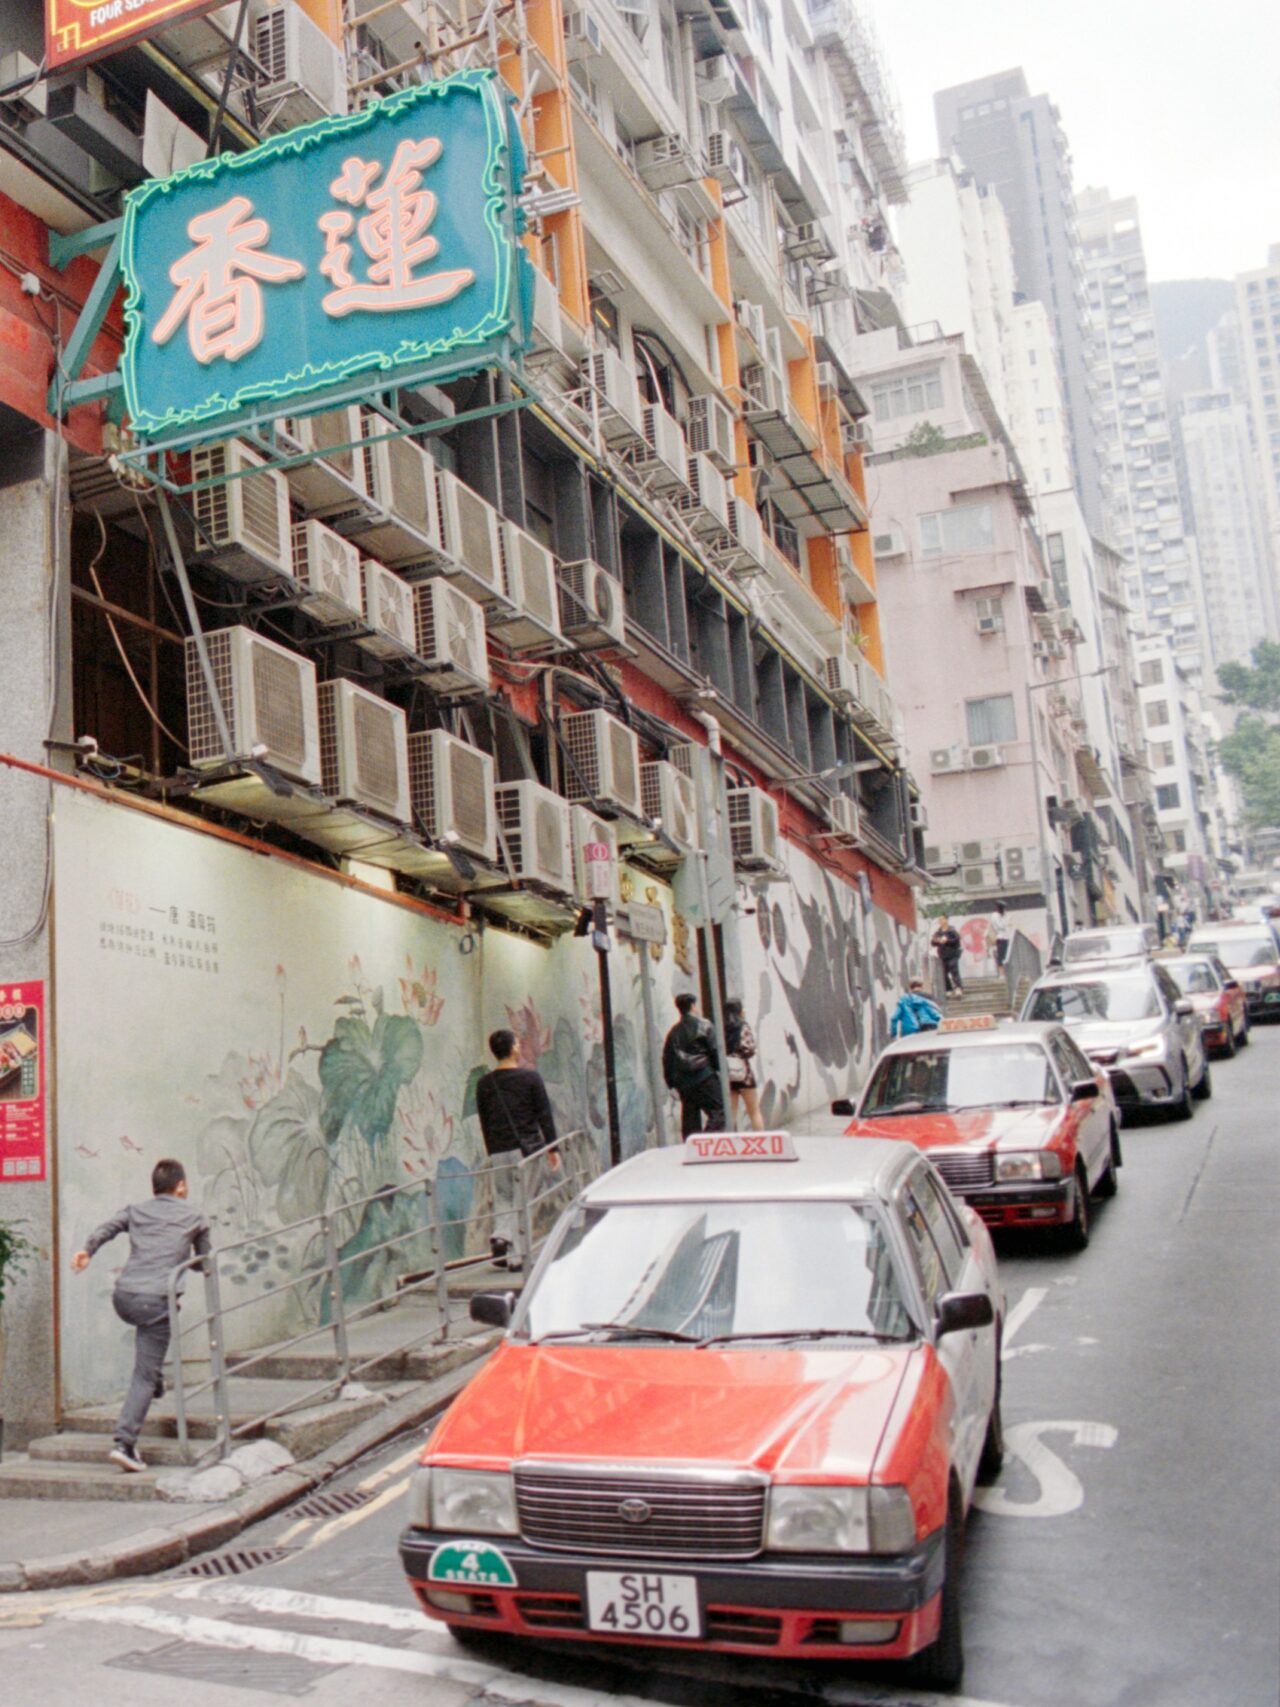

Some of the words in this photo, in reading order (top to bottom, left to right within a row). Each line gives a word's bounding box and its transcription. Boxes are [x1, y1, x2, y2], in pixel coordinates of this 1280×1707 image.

[90, 1, 123, 28] FOUR
[941, 1016, 990, 1031] TAXI
[690, 1135, 784, 1157] TAXI
[460, 1553, 480, 1572] 4
[445, 1569, 499, 1583] SEATS
[620, 1575, 664, 1604] SH
[600, 1602, 690, 1633] 4506
